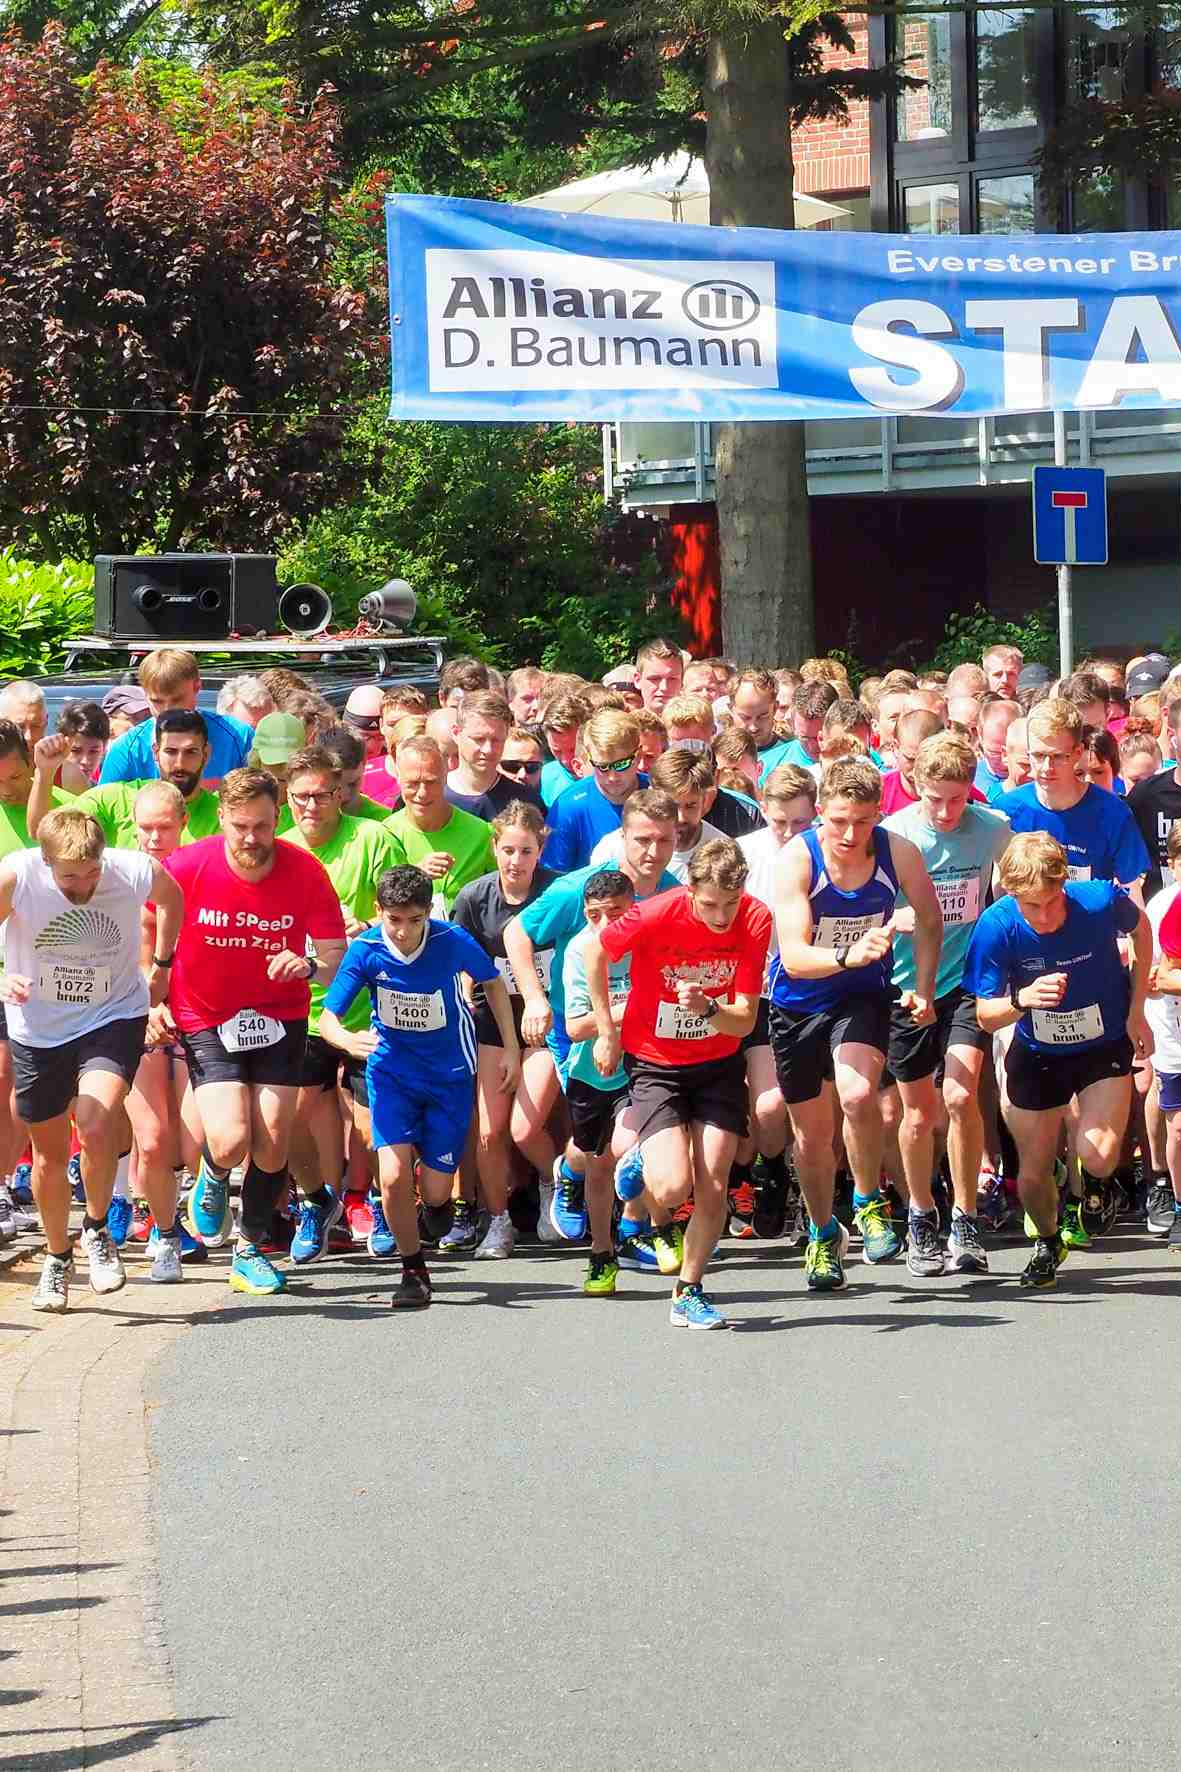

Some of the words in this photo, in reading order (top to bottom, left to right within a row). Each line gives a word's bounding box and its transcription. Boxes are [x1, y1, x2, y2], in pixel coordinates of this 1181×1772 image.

[887, 248, 1117, 274] Everstener
[442, 276, 663, 320] Allianz
[443, 326, 496, 369] D.
[509, 326, 763, 368] Baumann
[940, 896, 966, 910] 110
[197, 907, 230, 928] Mit
[235, 911, 294, 931] SPeeD
[943, 911, 963, 922] uns
[204, 935, 247, 948] zum
[251, 935, 287, 951] Ziel
[54, 979, 94, 993] 1072
[56, 990, 91, 1003] bruns
[392, 1005, 429, 1018] 1400
[239, 1018, 266, 1032] 540
[394, 1015, 427, 1028] bruns
[1057, 1024, 1076, 1033] 31
[237, 1032, 270, 1047] bruns
[675, 1029, 709, 1039] bruns
[1052, 1032, 1086, 1042] bruns
